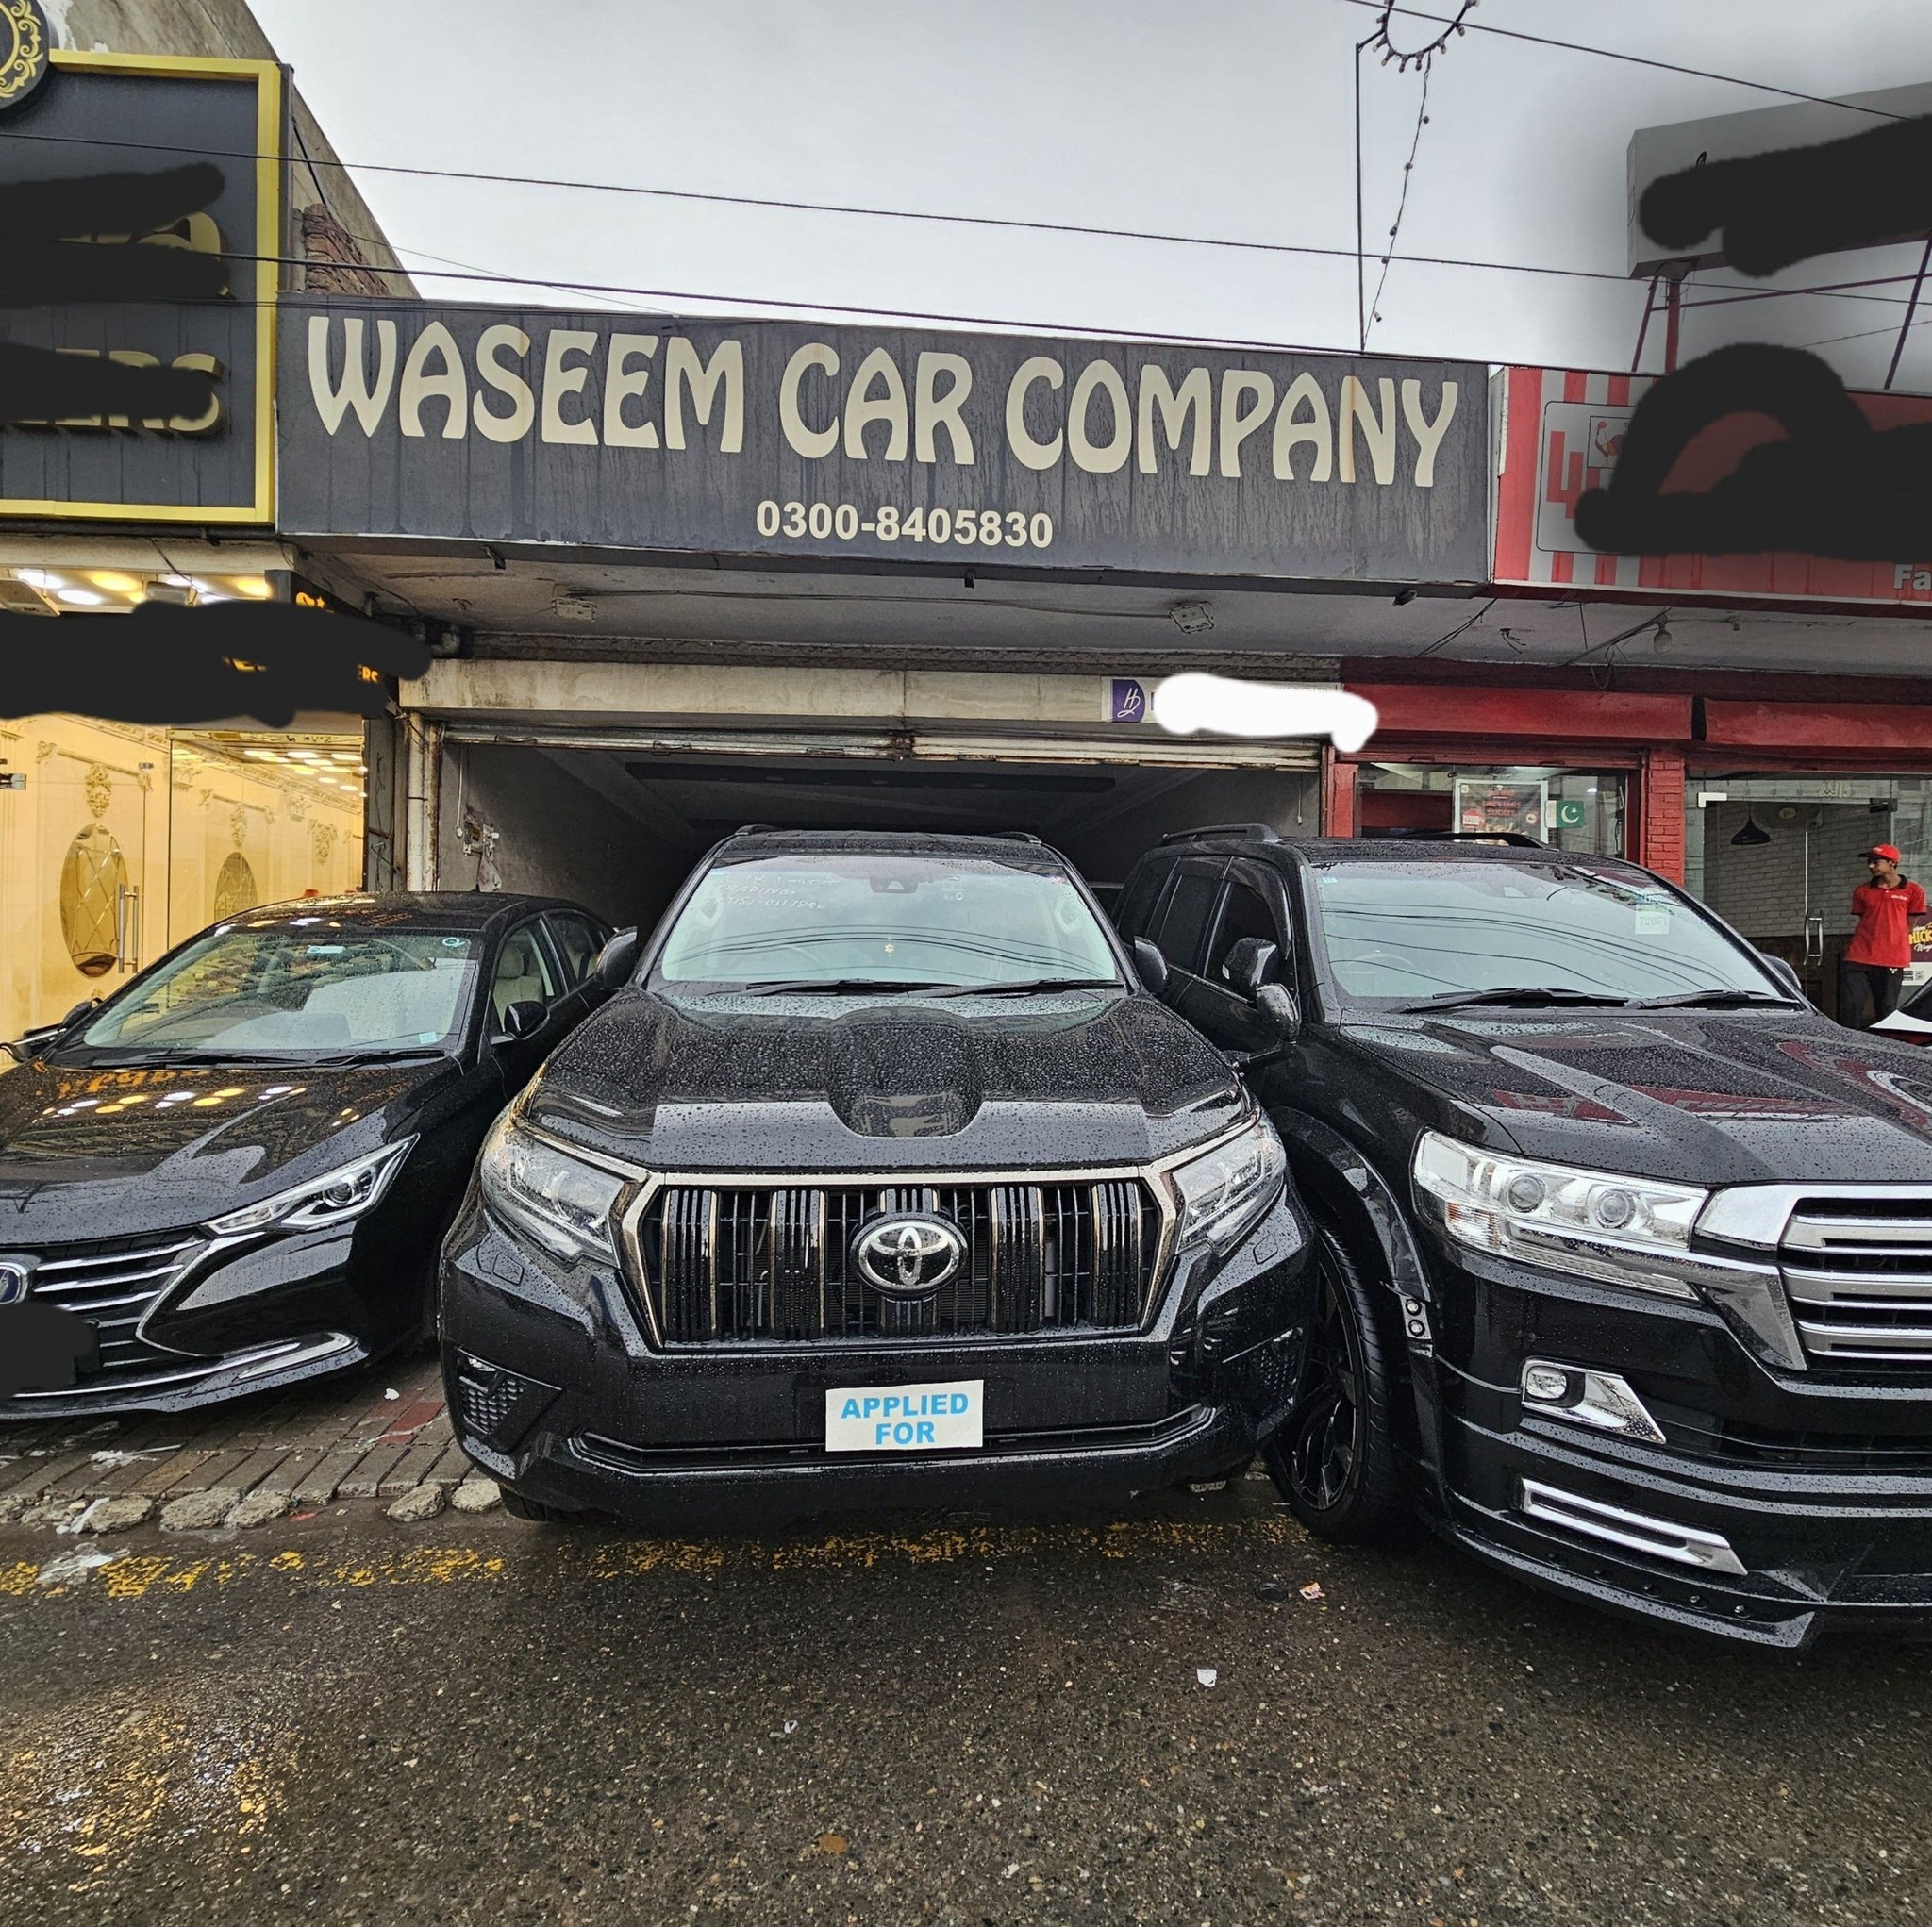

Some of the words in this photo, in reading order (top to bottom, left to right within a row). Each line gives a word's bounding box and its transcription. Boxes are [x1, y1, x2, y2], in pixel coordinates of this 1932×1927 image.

[308, 315, 744, 453] WASEEM
[779, 342, 974, 465] CAR
[1006, 356, 1458, 487] COMPANY
[756, 500, 1054, 549] 0300-8405830
[841, 1393, 969, 1420] APPLIED
[875, 1421, 936, 1445] FOR
